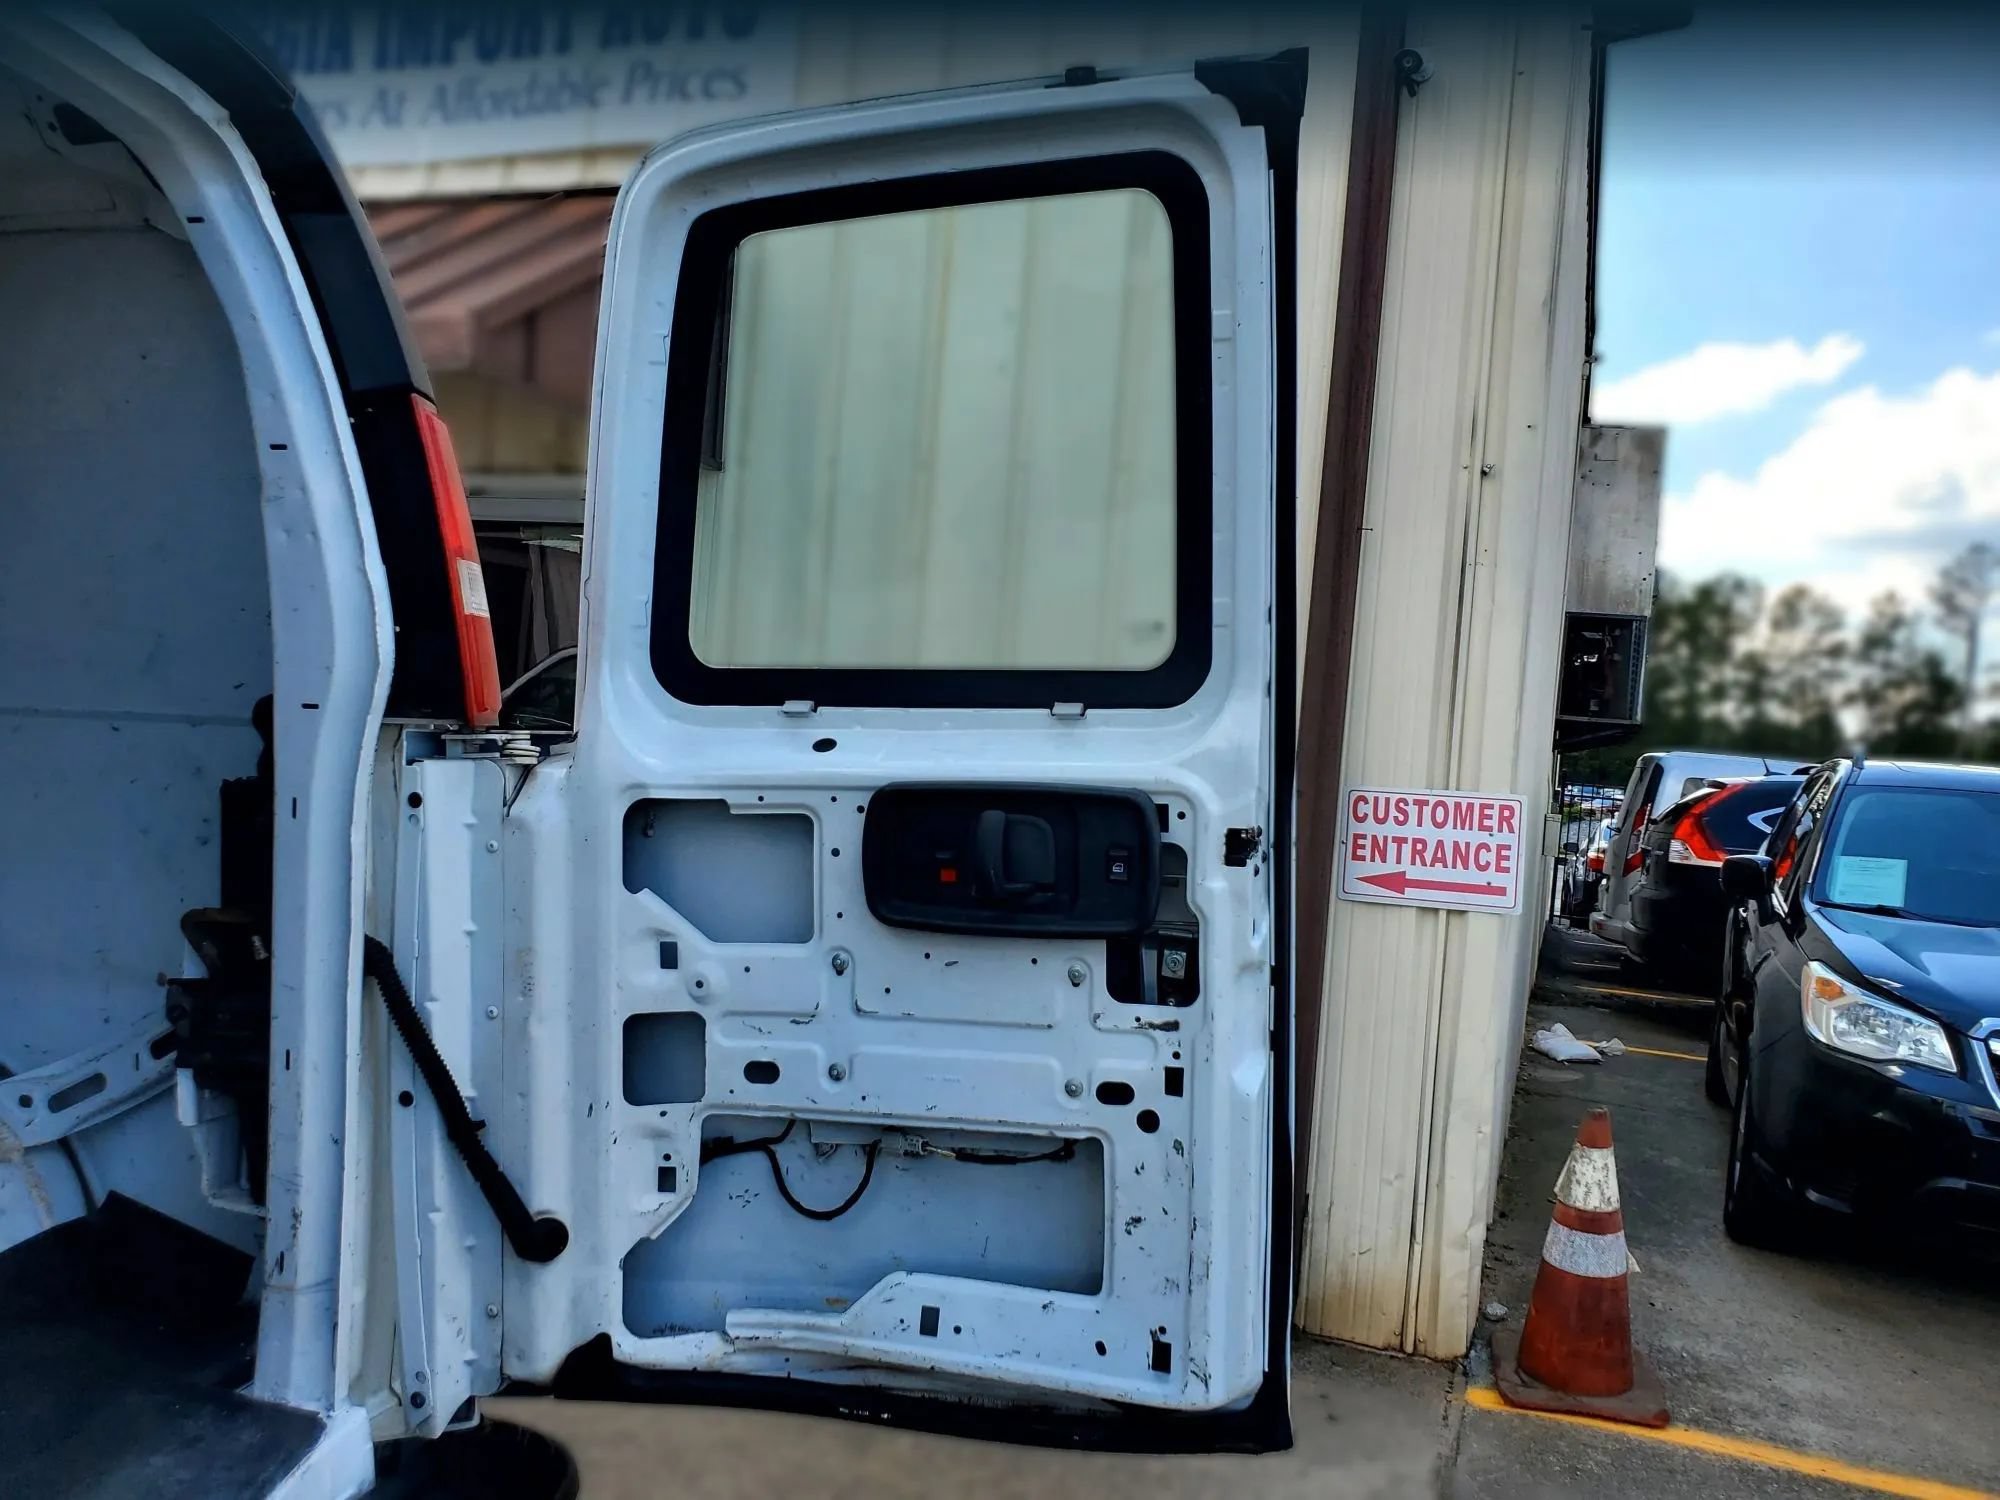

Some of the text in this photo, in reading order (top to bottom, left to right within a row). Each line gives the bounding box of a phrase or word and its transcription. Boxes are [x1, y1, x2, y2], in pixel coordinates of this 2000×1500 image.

[621, 58, 749, 107] Prices
[1352, 794, 1516, 834] CUSTOMER
[1351, 832, 1512, 874] ENTRANCE
